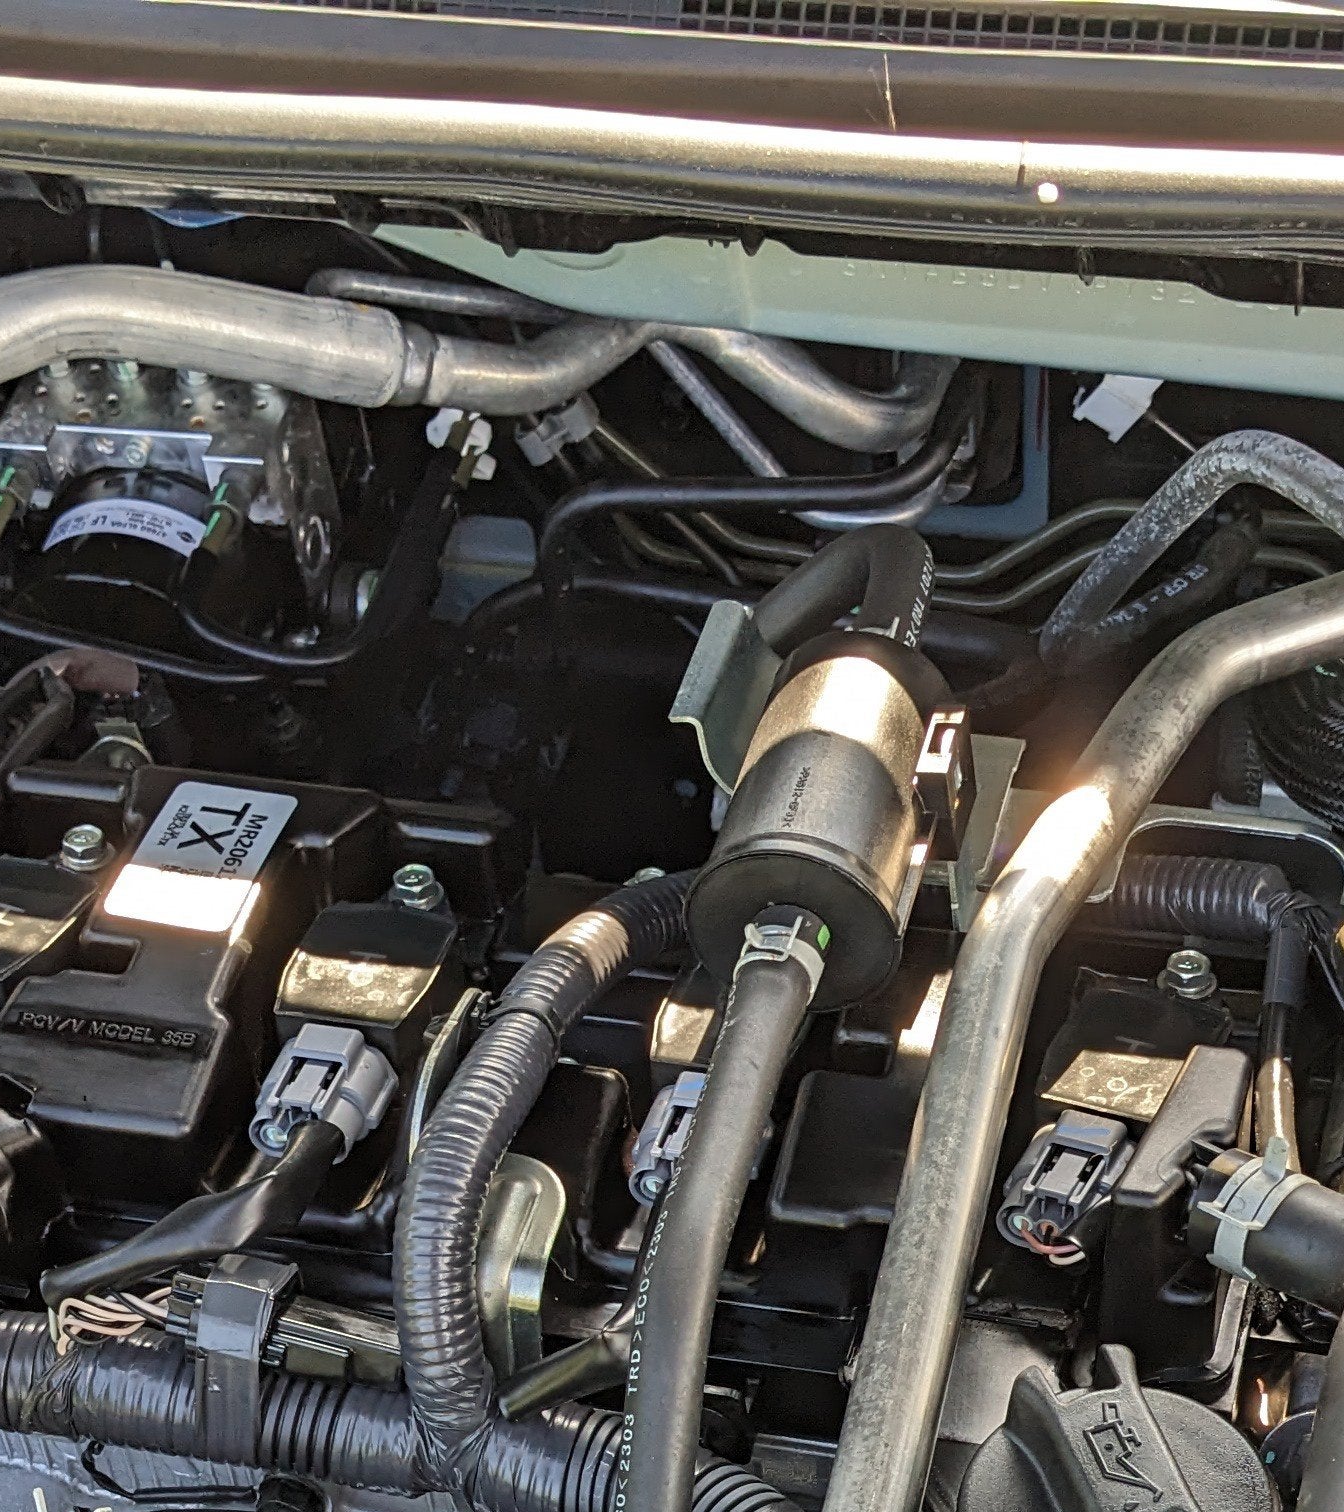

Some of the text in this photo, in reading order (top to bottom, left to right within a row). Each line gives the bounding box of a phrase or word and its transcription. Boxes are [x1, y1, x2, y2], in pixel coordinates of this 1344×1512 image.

[177, 802, 252, 855] TX
[219, 814, 269, 876] MR2061
[89, 1019, 156, 1043] MODEL
